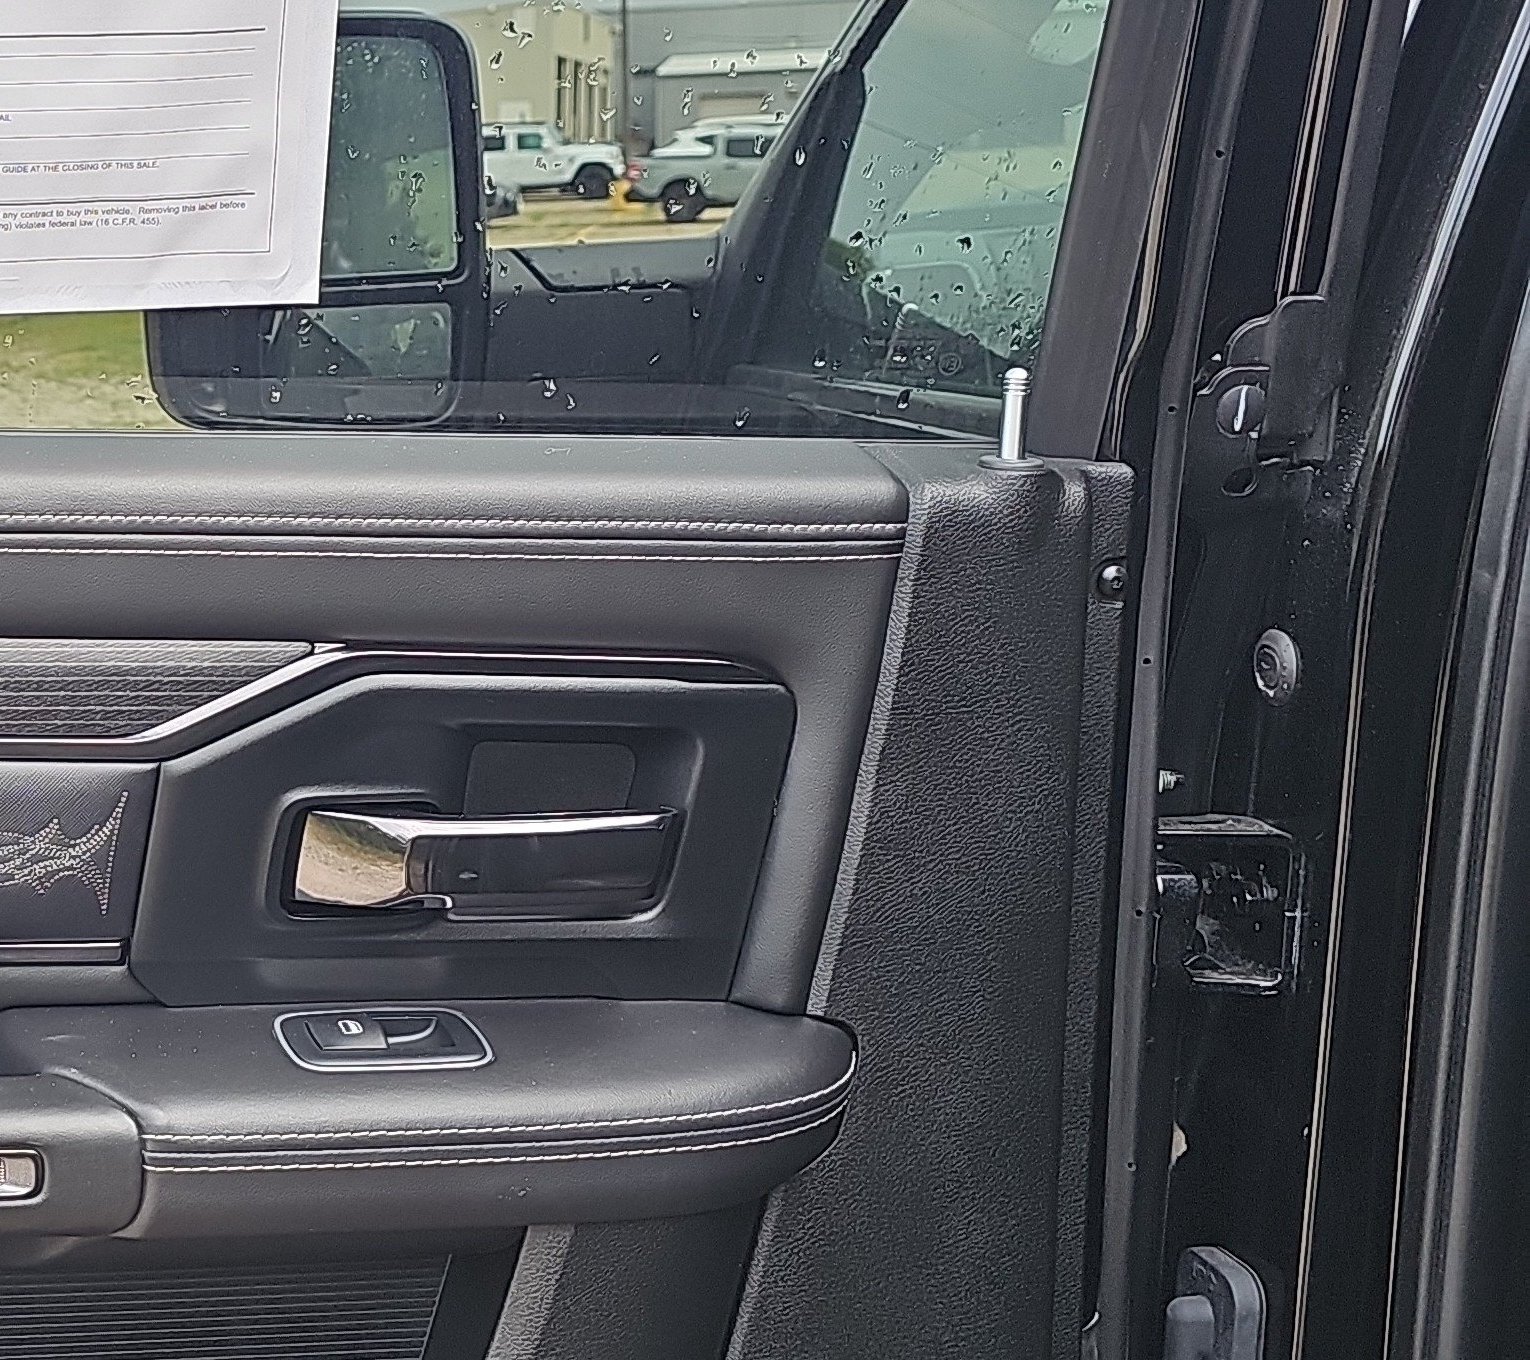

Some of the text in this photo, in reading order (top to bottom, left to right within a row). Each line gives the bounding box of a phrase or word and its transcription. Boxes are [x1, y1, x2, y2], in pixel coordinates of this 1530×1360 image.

[2, 164, 28, 173] GUIDE
[30, 164, 40, 172] AT
[43, 163, 59, 172] THE
[62, 162, 99, 171] CLOSING
[101, 162, 112, 170] OF
[116, 162, 134, 170] THIS
[3, 210, 17, 219] any
[20, 208, 53, 218] contract
[56, 208, 63, 217] to
[66, 207, 81, 218] buy
[84, 207, 98, 216] this
[138, 203, 179, 215] Removing
[182, 203, 195, 212] this
[198, 202, 217, 211] label
[219, 201, 245, 210] before
[14, 220, 45, 229] violates
[48, 219, 76, 229] federal
[79, 219, 93, 228] law
